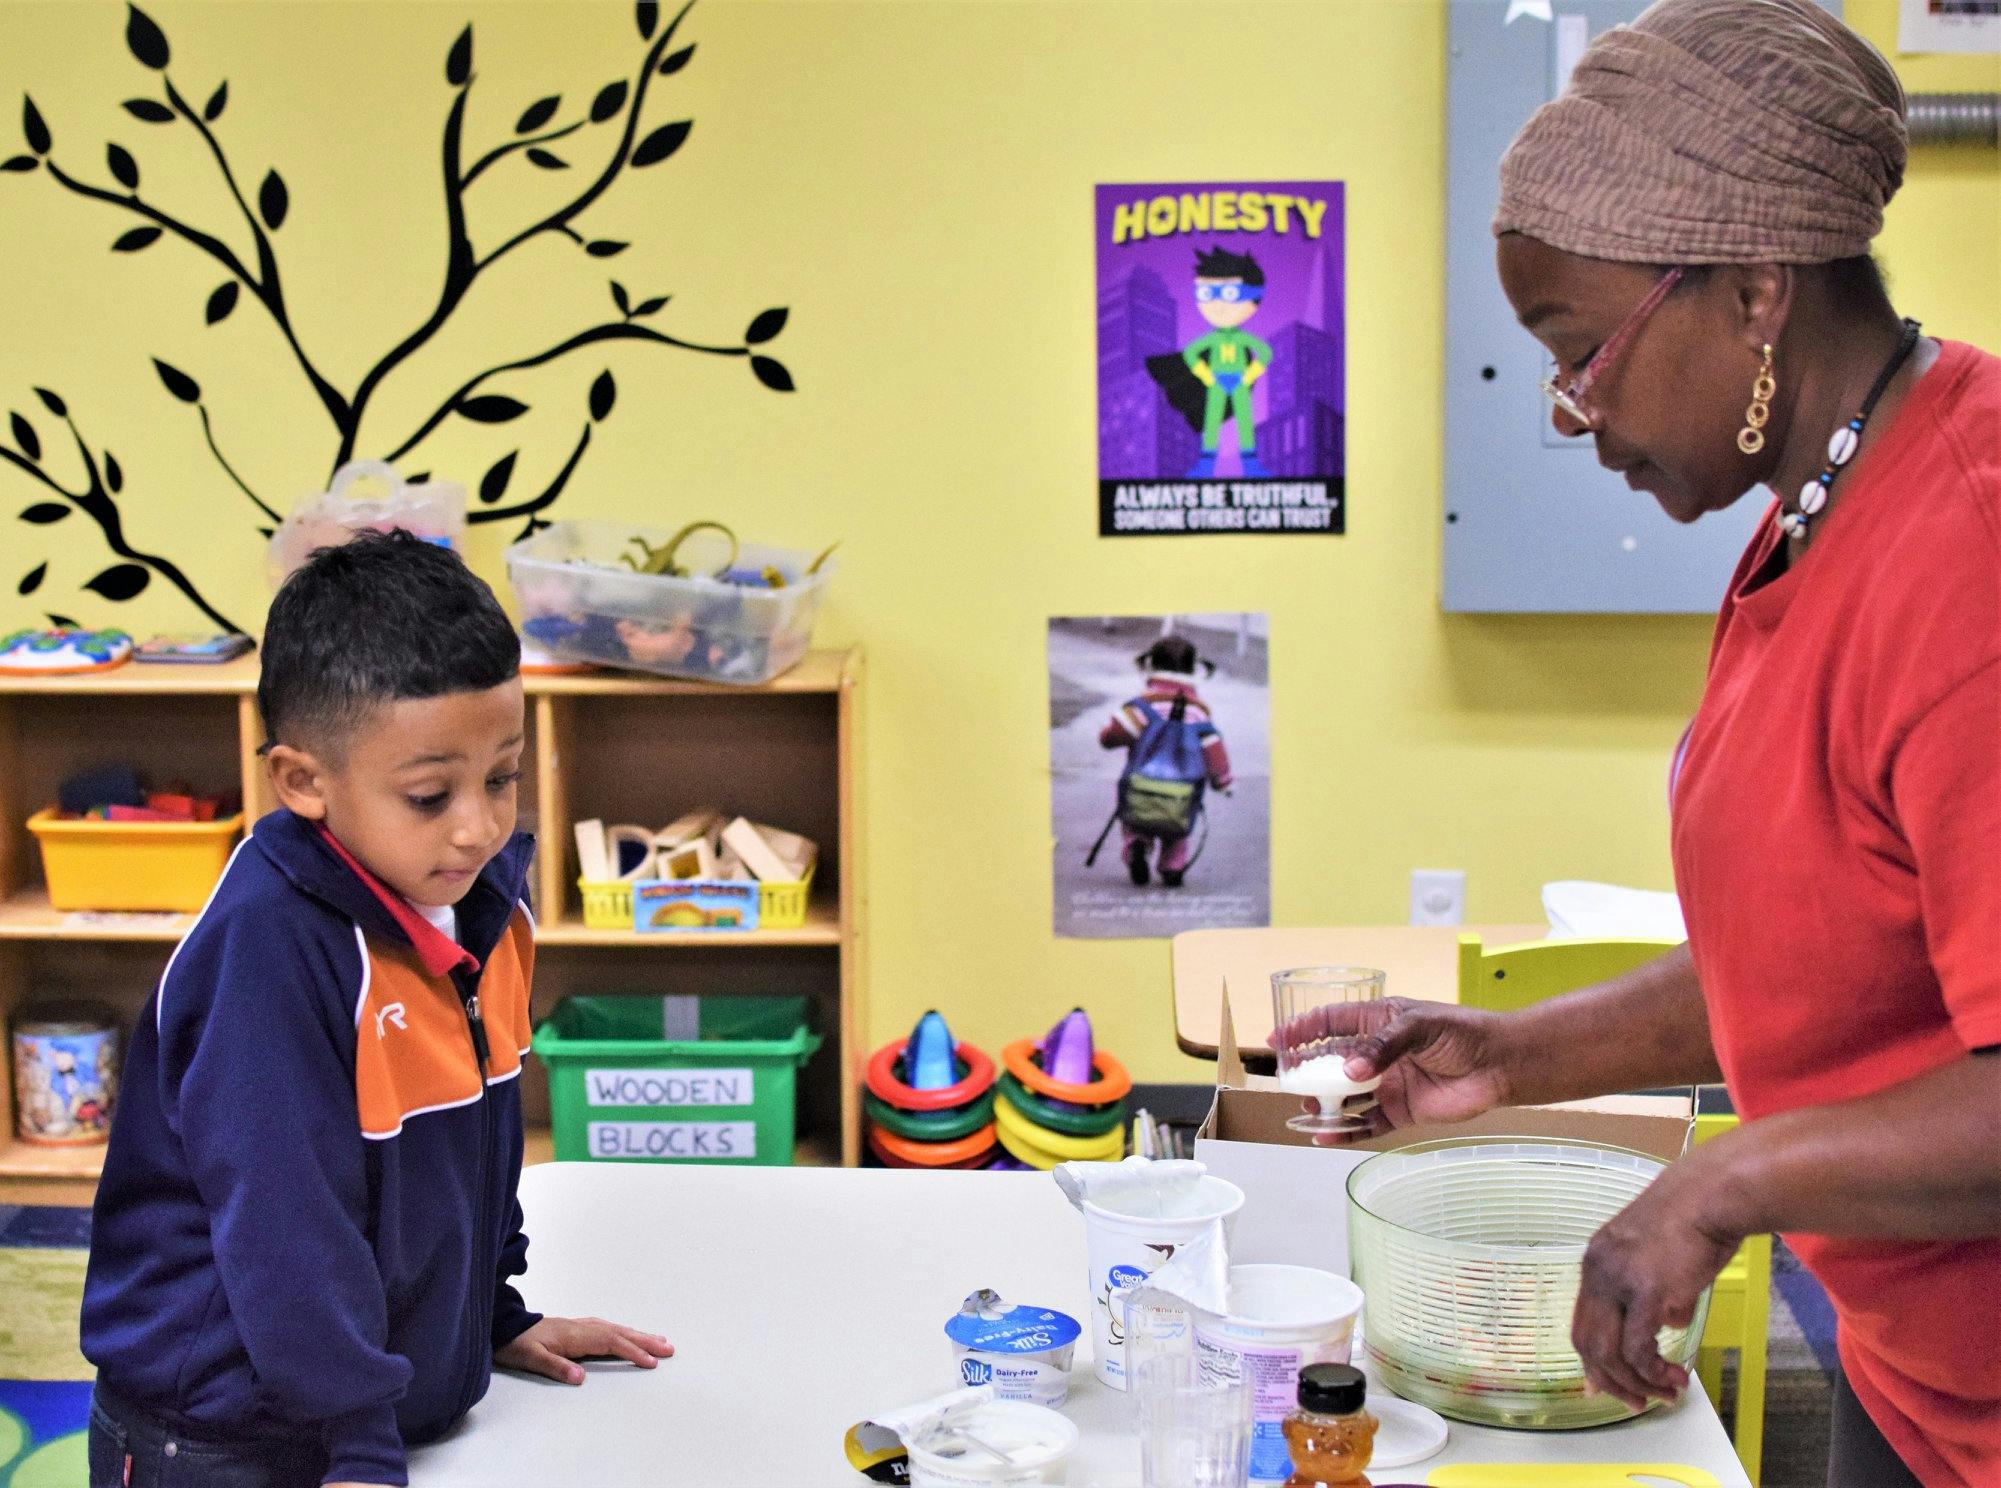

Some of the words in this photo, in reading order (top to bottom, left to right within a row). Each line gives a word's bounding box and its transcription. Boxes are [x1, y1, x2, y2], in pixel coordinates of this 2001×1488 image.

[1112, 191, 1327, 244] HONESTY
[1219, 344, 1236, 364] H
[1114, 484, 1199, 508] ALWAYS
[1201, 484, 1227, 508] BE
[1229, 482, 1339, 509] TRUTHFUL,
[1114, 508, 1186, 531] SOMEONE
[1187, 508, 1246, 530] OTHERS
[1247, 507, 1282, 529] CAN
[1282, 507, 1332, 529] TRUST
[594, 1074, 738, 1103] WOODEN
[597, 1126, 734, 1156] BLOCKS
[1006, 1332, 1052, 1349] Silk
[961, 1359, 990, 1384] Silk
[996, 1369, 1039, 1378] Dairy-Free
